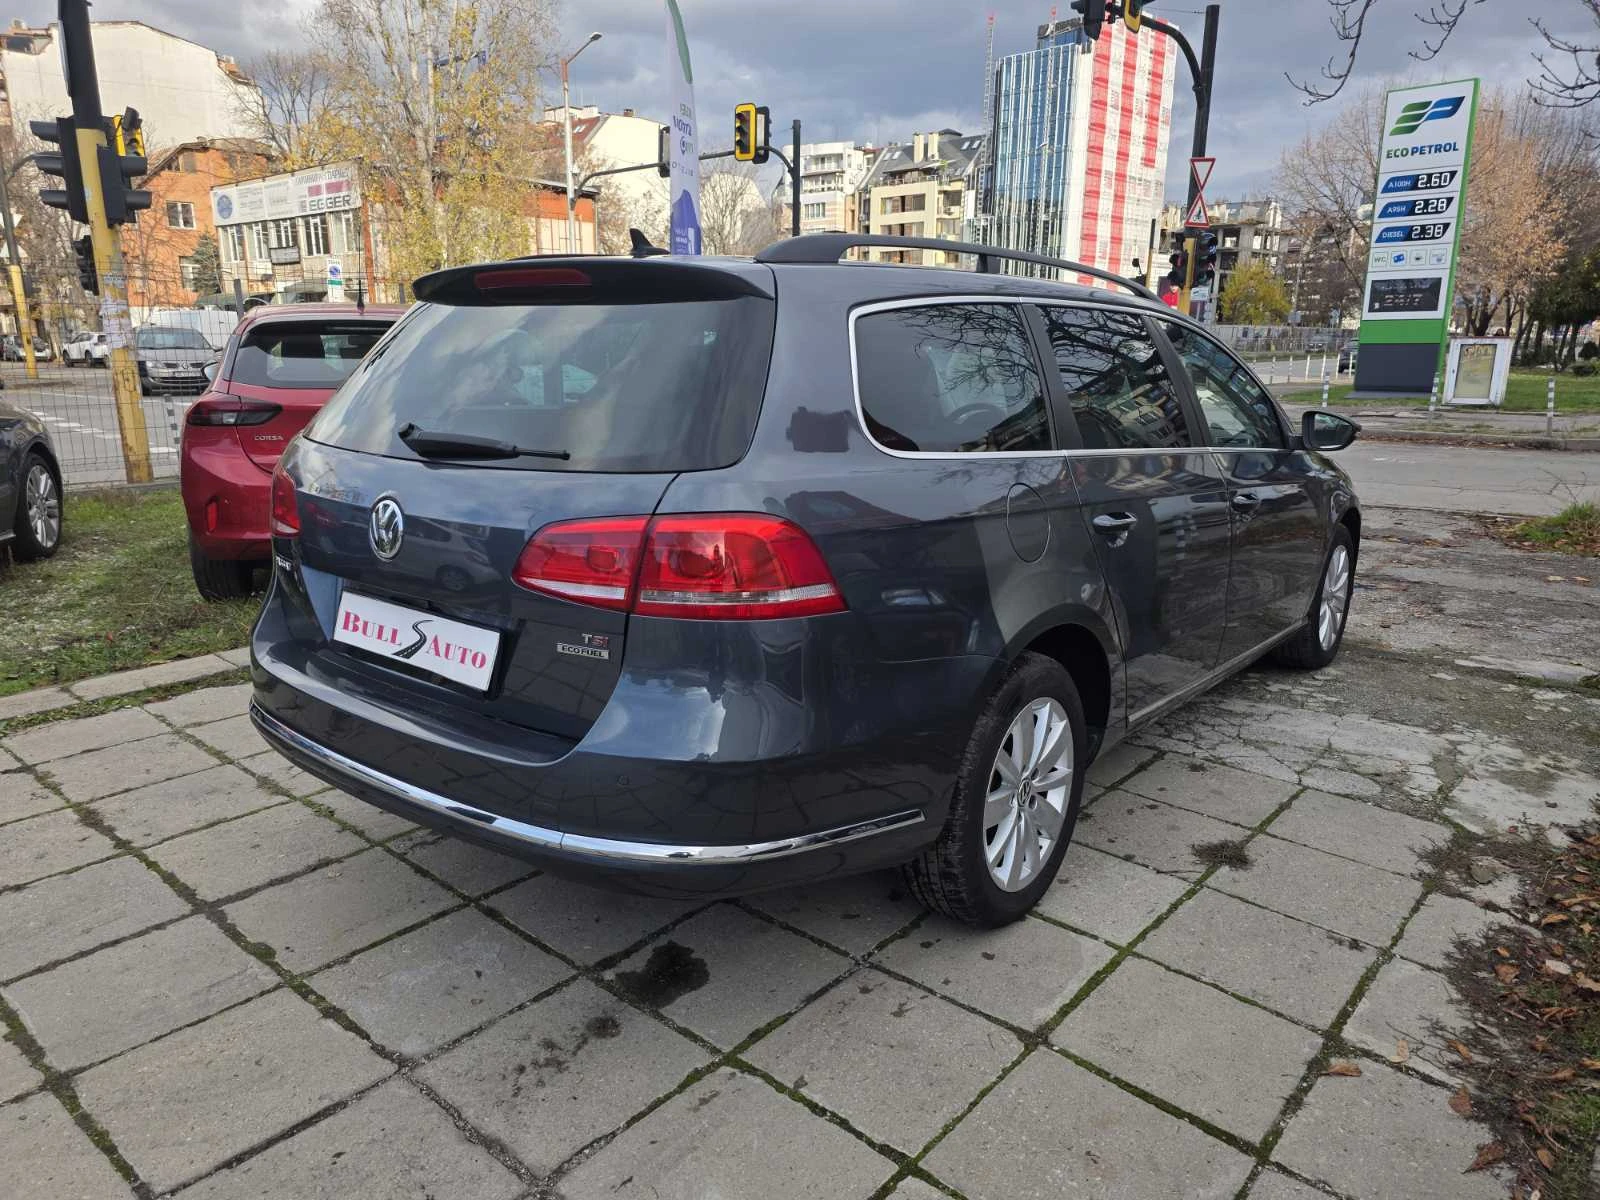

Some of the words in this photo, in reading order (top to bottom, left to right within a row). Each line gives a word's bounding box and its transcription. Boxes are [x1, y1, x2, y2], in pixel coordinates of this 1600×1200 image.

[1386, 142, 1459, 159] ECOPETROL
[1417, 172, 1450, 188] 2.60
[308, 194, 352, 212] EGGER
[1414, 198, 1447, 214] 2.28
[1382, 230, 1404, 239] DIESEL
[1411, 224, 1444, 239] 2.38
[341, 610, 403, 647] BULL
[425, 634, 487, 670] AUTO
[560, 643, 606, 658] ECOFUEL
